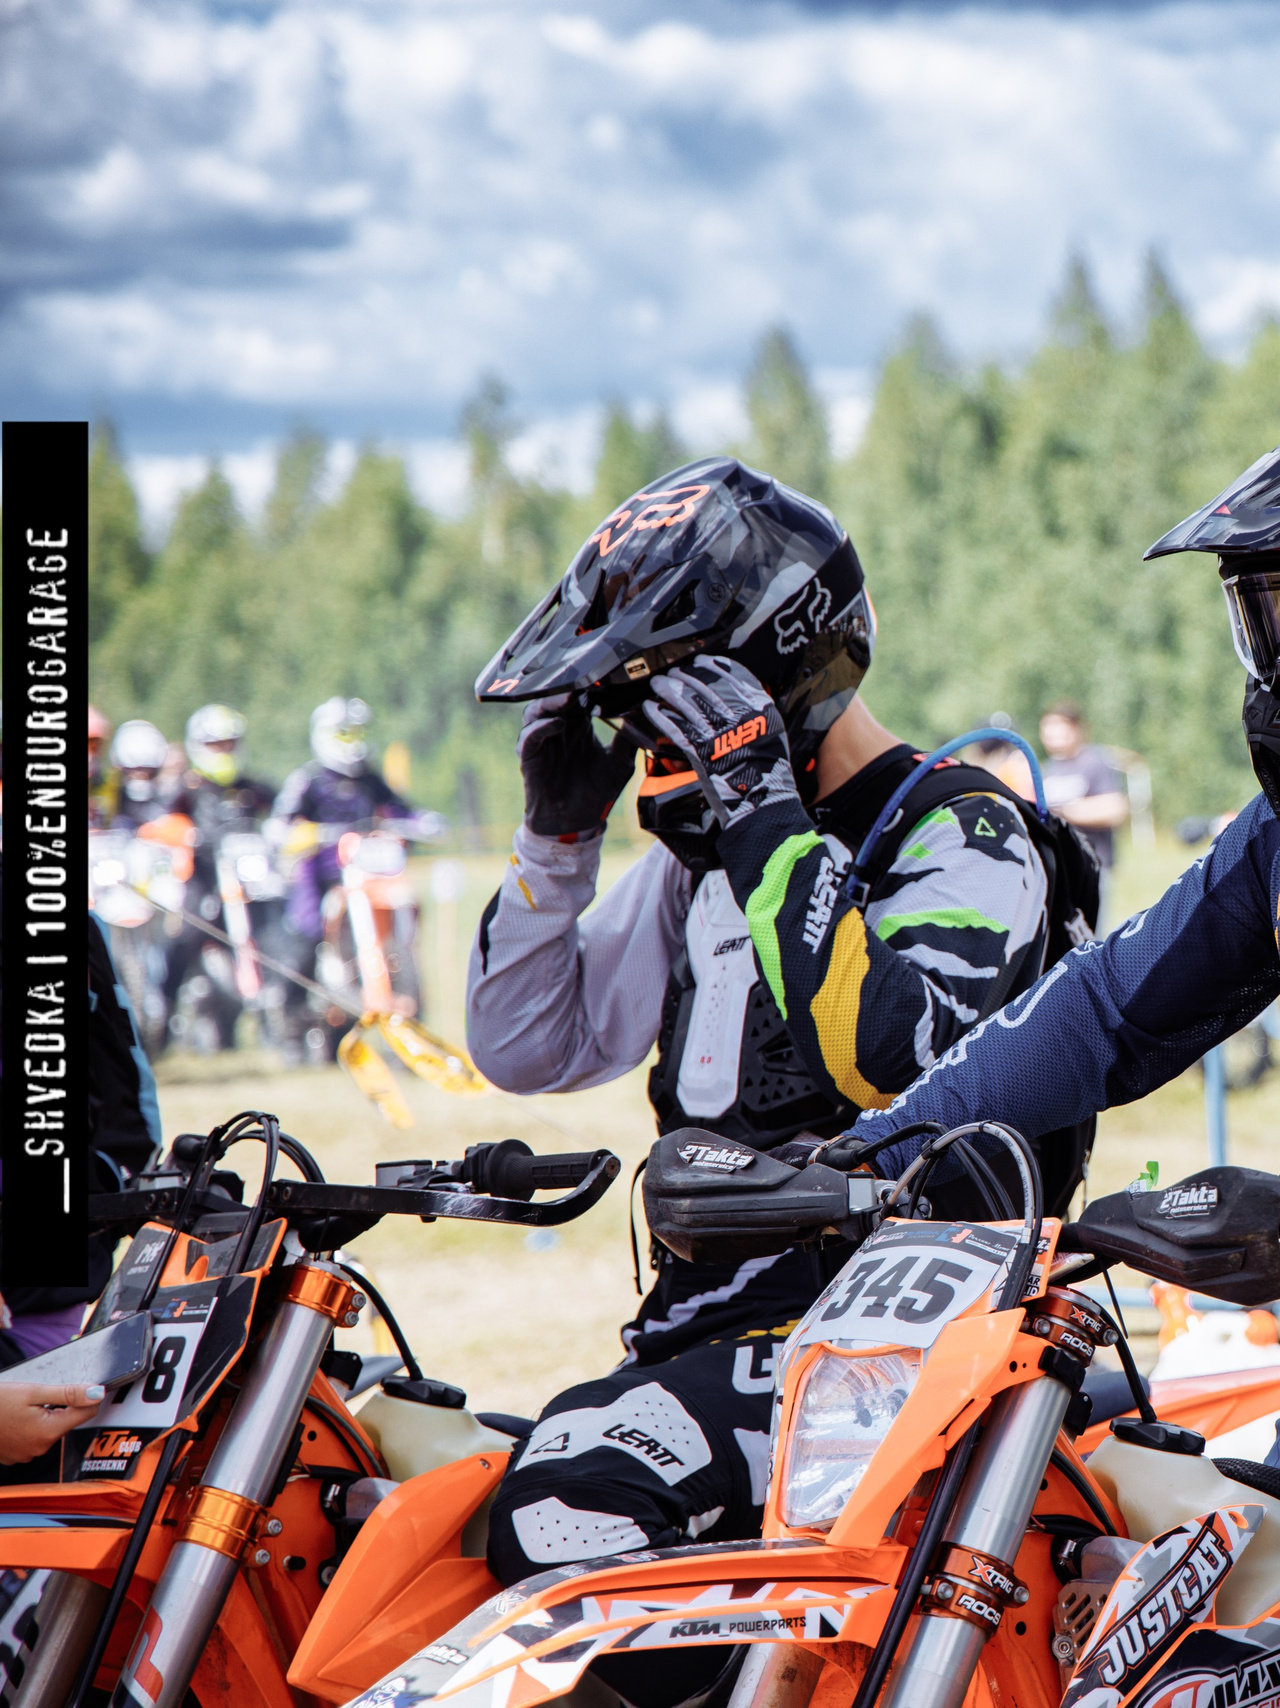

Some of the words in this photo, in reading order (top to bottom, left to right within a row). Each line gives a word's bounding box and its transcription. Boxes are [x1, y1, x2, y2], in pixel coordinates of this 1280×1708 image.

[711, 715, 767, 761] LEATT
[802, 856, 843, 955] LEATT
[713, 935, 751, 957] LEATT
[680, 1144, 754, 1166] 2Takta
[1159, 1186, 1218, 1210] 2Takta
[820, 1256, 973, 1324] 345
[1070, 1305, 1102, 1332] XTRIG
[1060, 1332, 1093, 1357] ROCS
[84, 1430, 139, 1457] KTM
[602, 1423, 685, 1468] LEATT
[969, 1555, 1014, 1595] XTRIG
[956, 1594, 1002, 1625] ROCS
